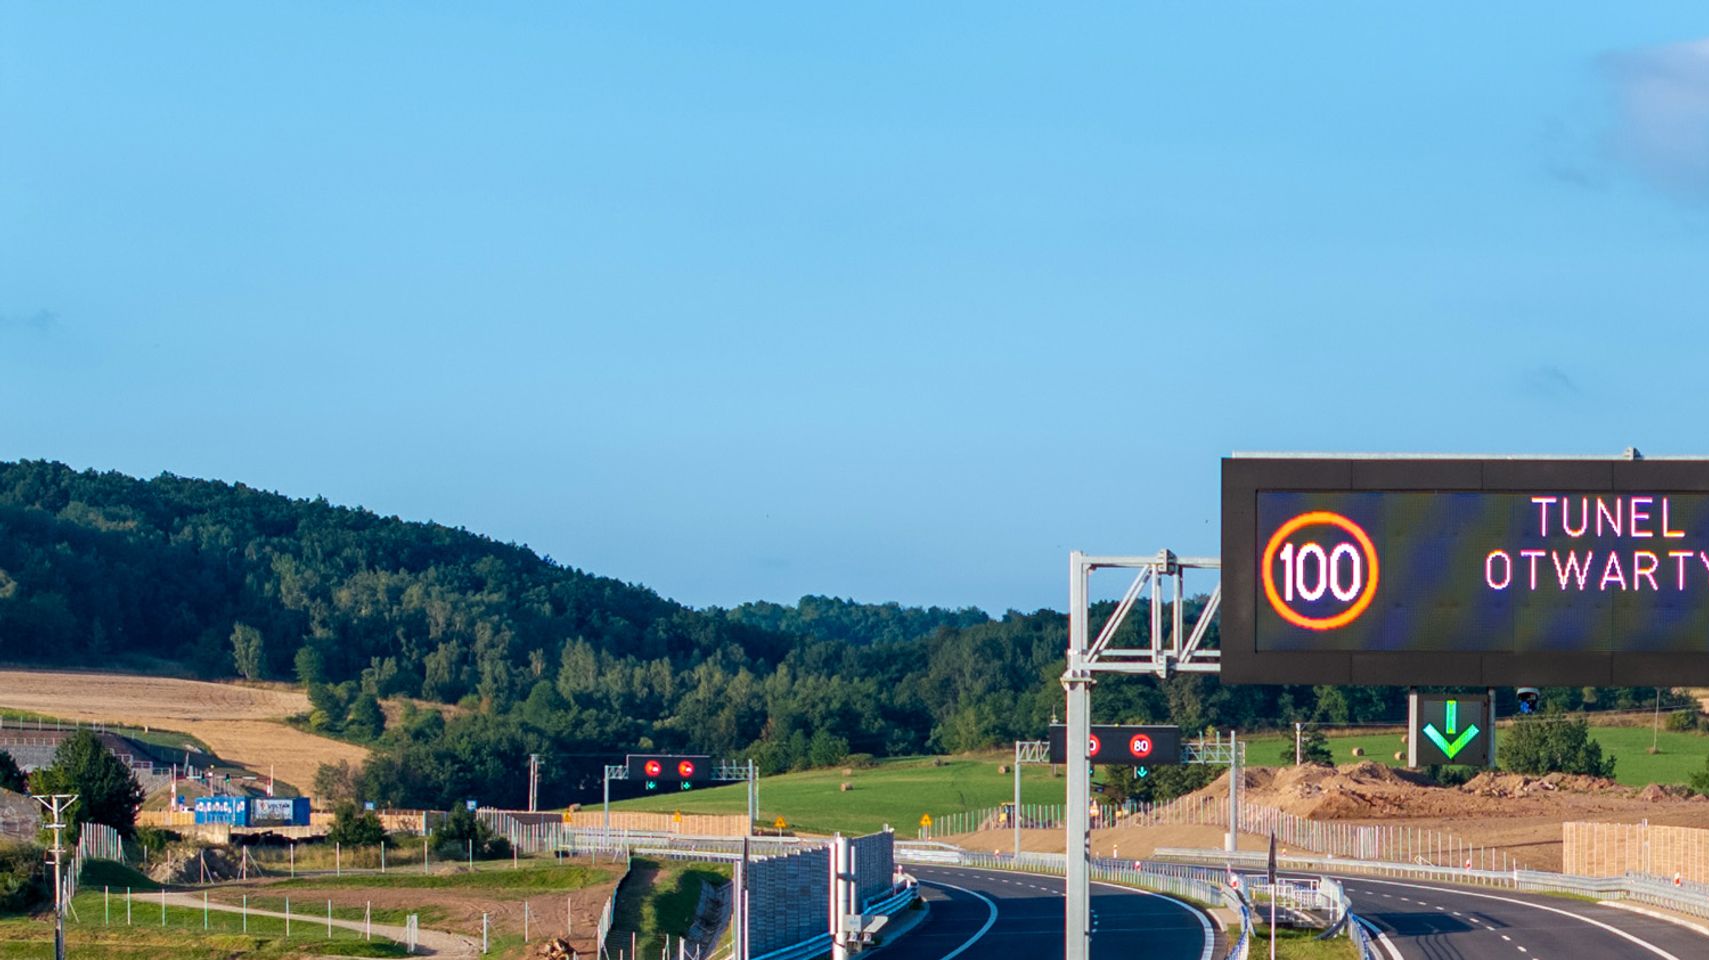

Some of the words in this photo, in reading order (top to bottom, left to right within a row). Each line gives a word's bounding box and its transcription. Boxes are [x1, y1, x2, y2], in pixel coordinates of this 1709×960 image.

[1531, 496, 1686, 538] TUNEL
[1280, 542, 1361, 602] 100
[1133, 740, 1149, 752] 80
